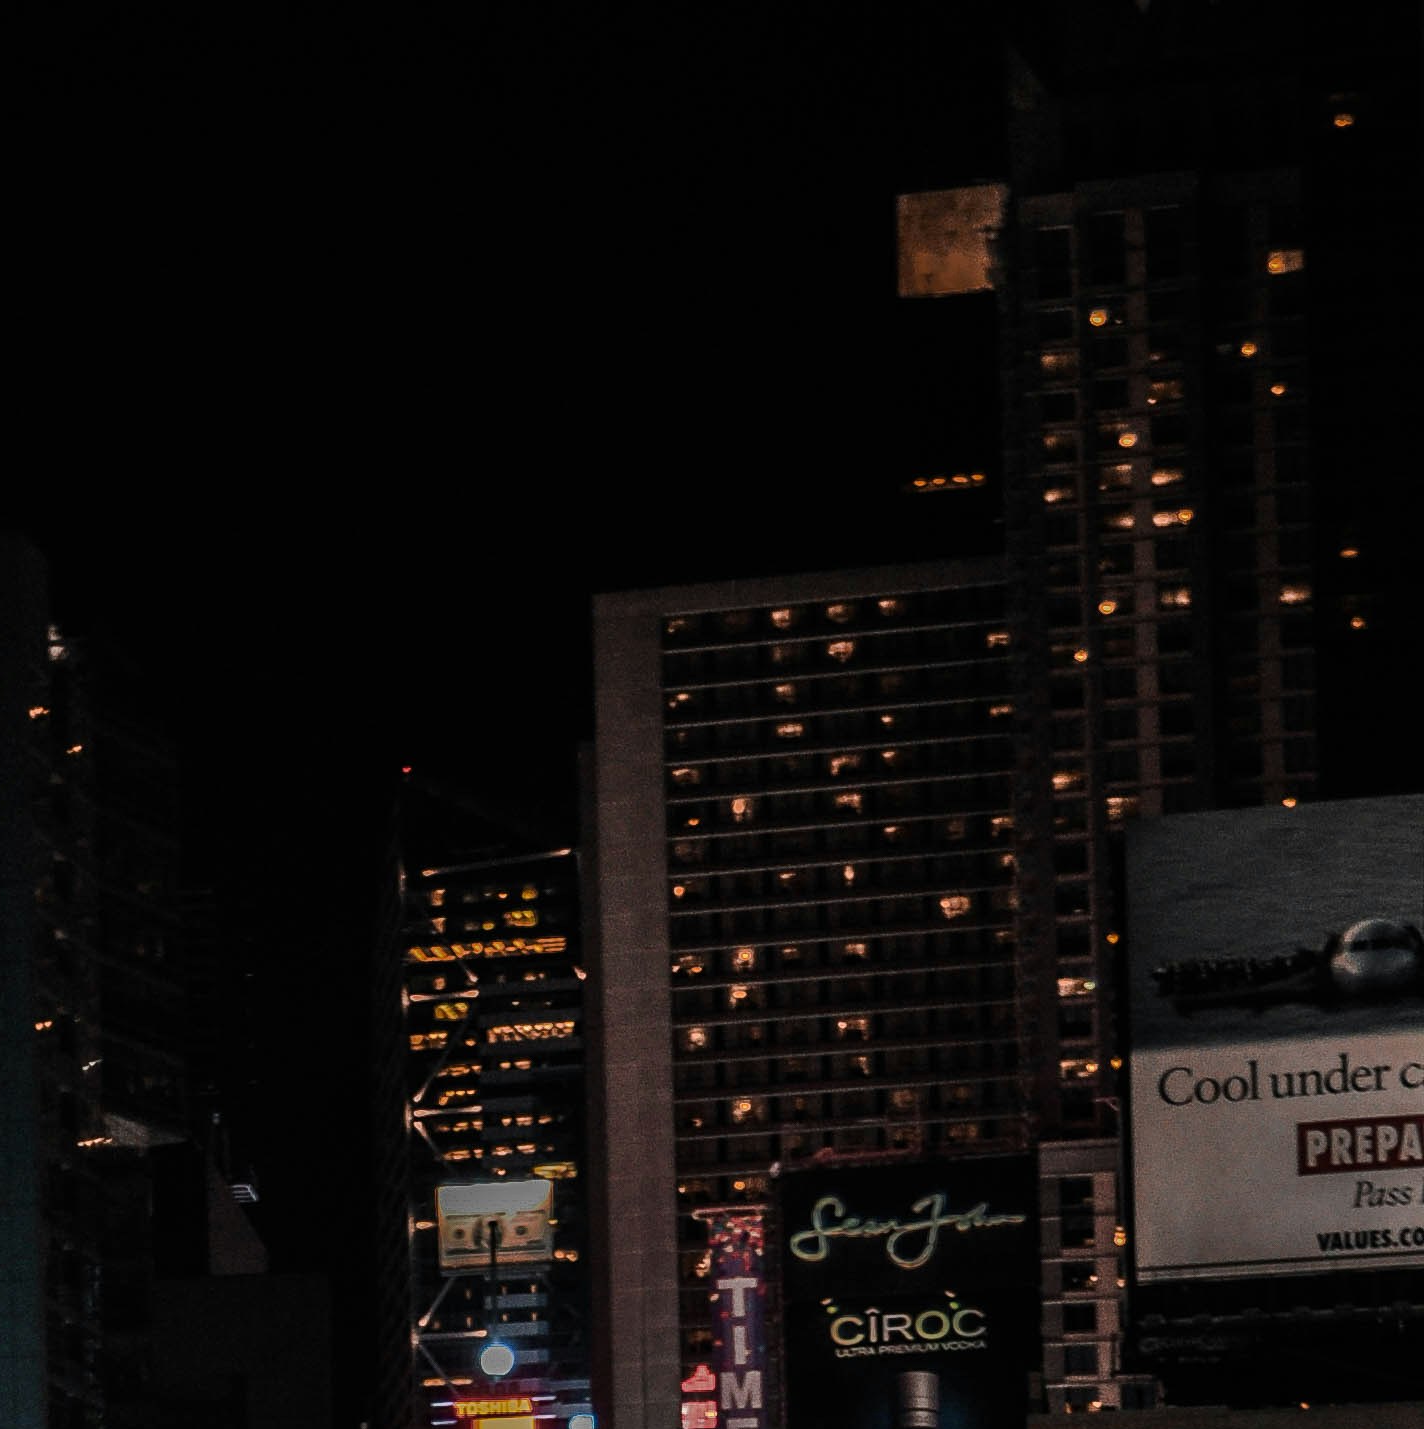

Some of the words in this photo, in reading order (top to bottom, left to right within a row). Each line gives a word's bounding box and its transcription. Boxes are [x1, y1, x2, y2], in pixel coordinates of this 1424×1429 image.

[1157, 1059, 1263, 1106] Cool
[1271, 1053, 1392, 1099] under
[1304, 1122, 1424, 1168] PREPA
[1353, 1180, 1413, 1208] Pass
[455, 1397, 533, 1417] TOSHIBA
